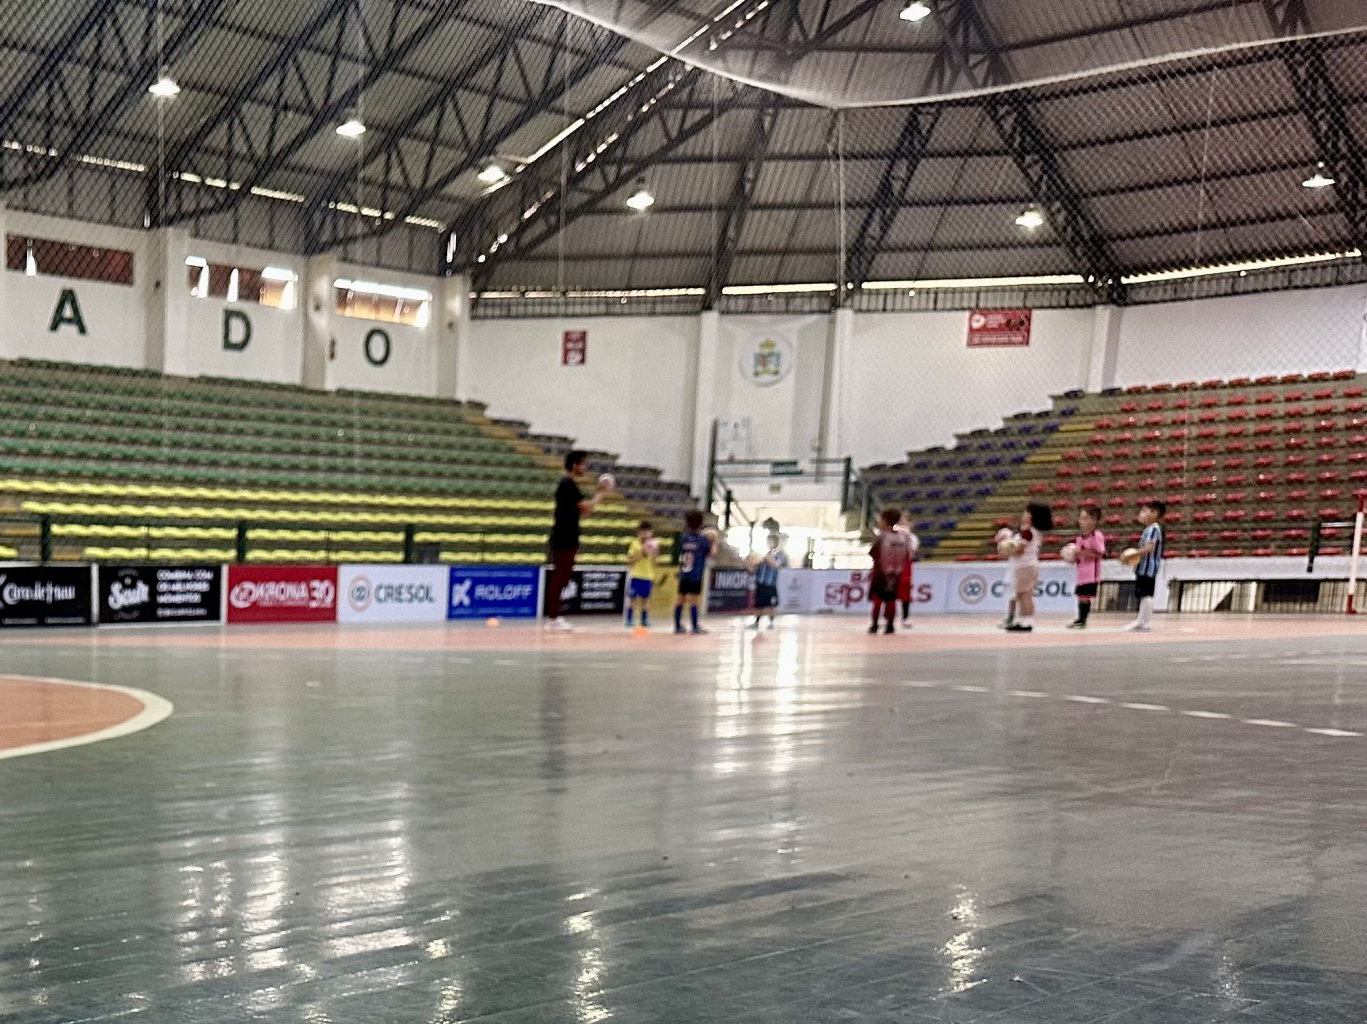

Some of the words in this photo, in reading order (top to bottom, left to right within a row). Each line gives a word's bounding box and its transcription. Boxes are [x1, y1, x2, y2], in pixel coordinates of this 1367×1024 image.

[256, 581, 308, 604] KRONA
[375, 584, 434, 602] CRESOL
[474, 584, 533, 600] ROLOFF
[990, 580, 1072, 598] CSOL
